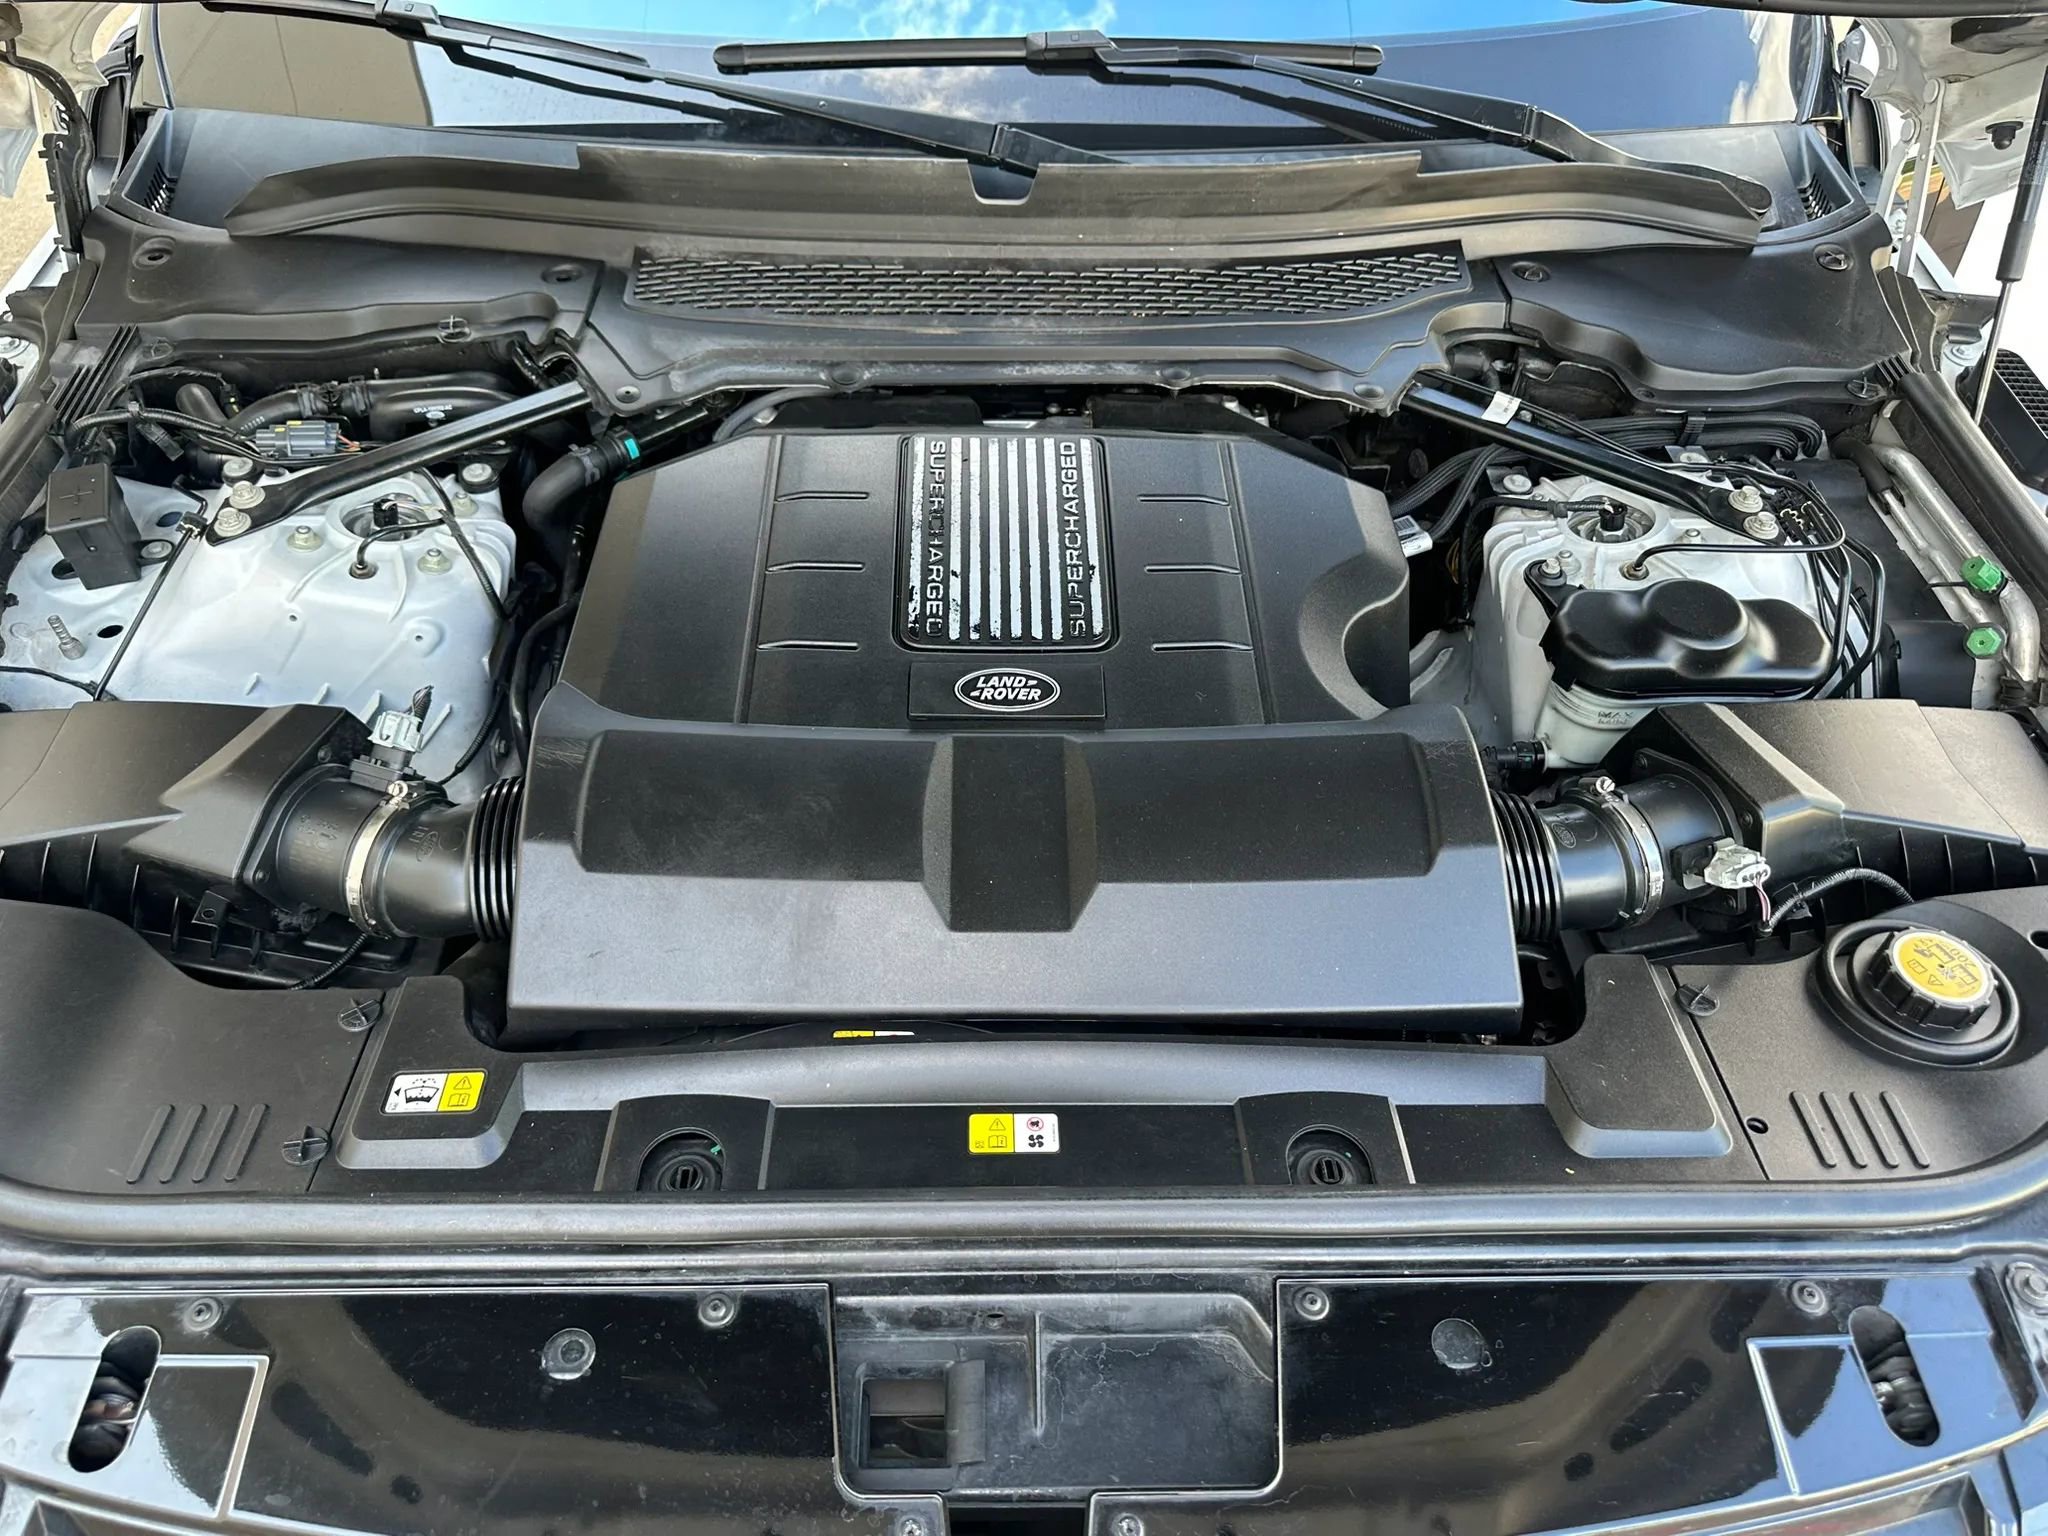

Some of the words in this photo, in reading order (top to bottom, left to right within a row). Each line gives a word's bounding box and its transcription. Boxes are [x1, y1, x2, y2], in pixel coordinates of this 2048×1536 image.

[925, 440, 946, 637] SUPERCHARGED
[1059, 441, 1087, 637] SUPERCHARGED
[980, 688, 1042, 701] ROVER
